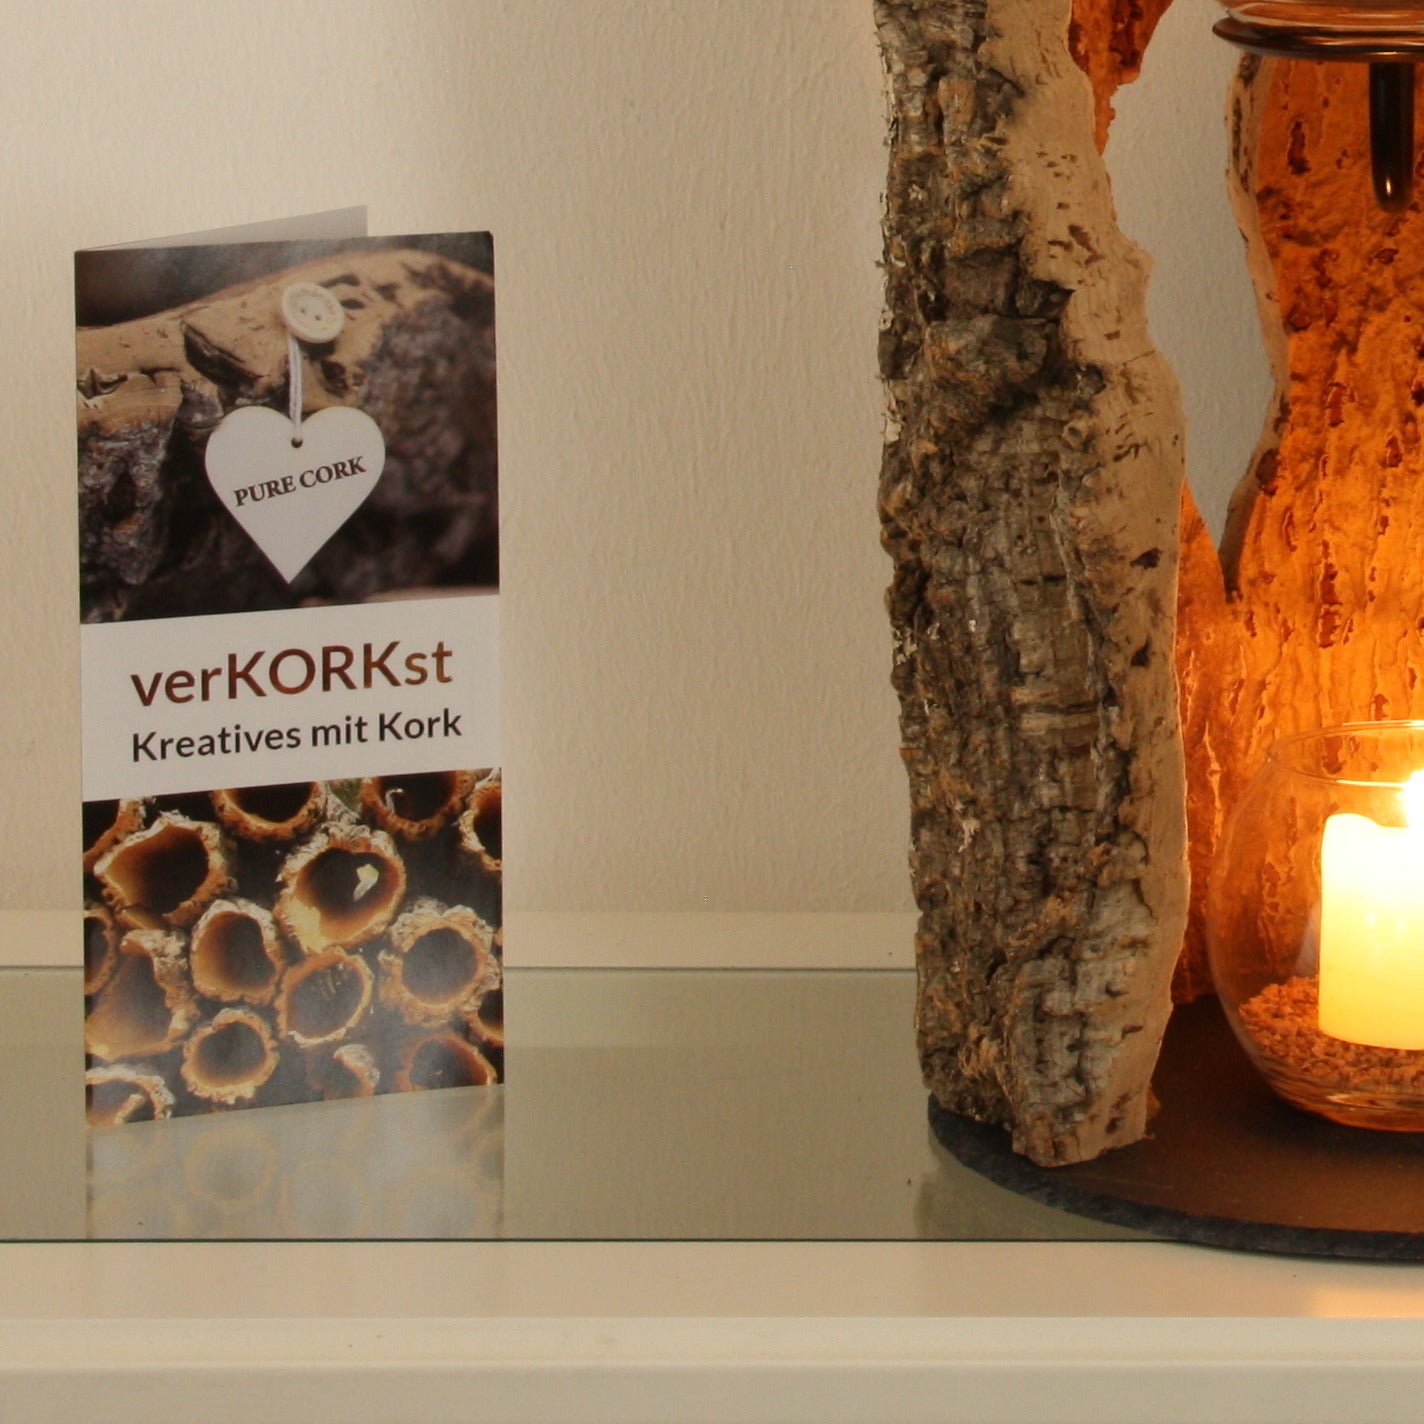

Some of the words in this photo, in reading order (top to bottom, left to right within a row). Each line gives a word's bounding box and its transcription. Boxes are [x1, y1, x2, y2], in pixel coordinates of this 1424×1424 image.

[234, 475, 297, 507] PURE
[299, 456, 367, 489] CORK
[130, 640, 453, 707] verKORKst
[132, 724, 301, 762] Kreatives
[311, 715, 368, 747] mit
[378, 708, 463, 742] Kork
